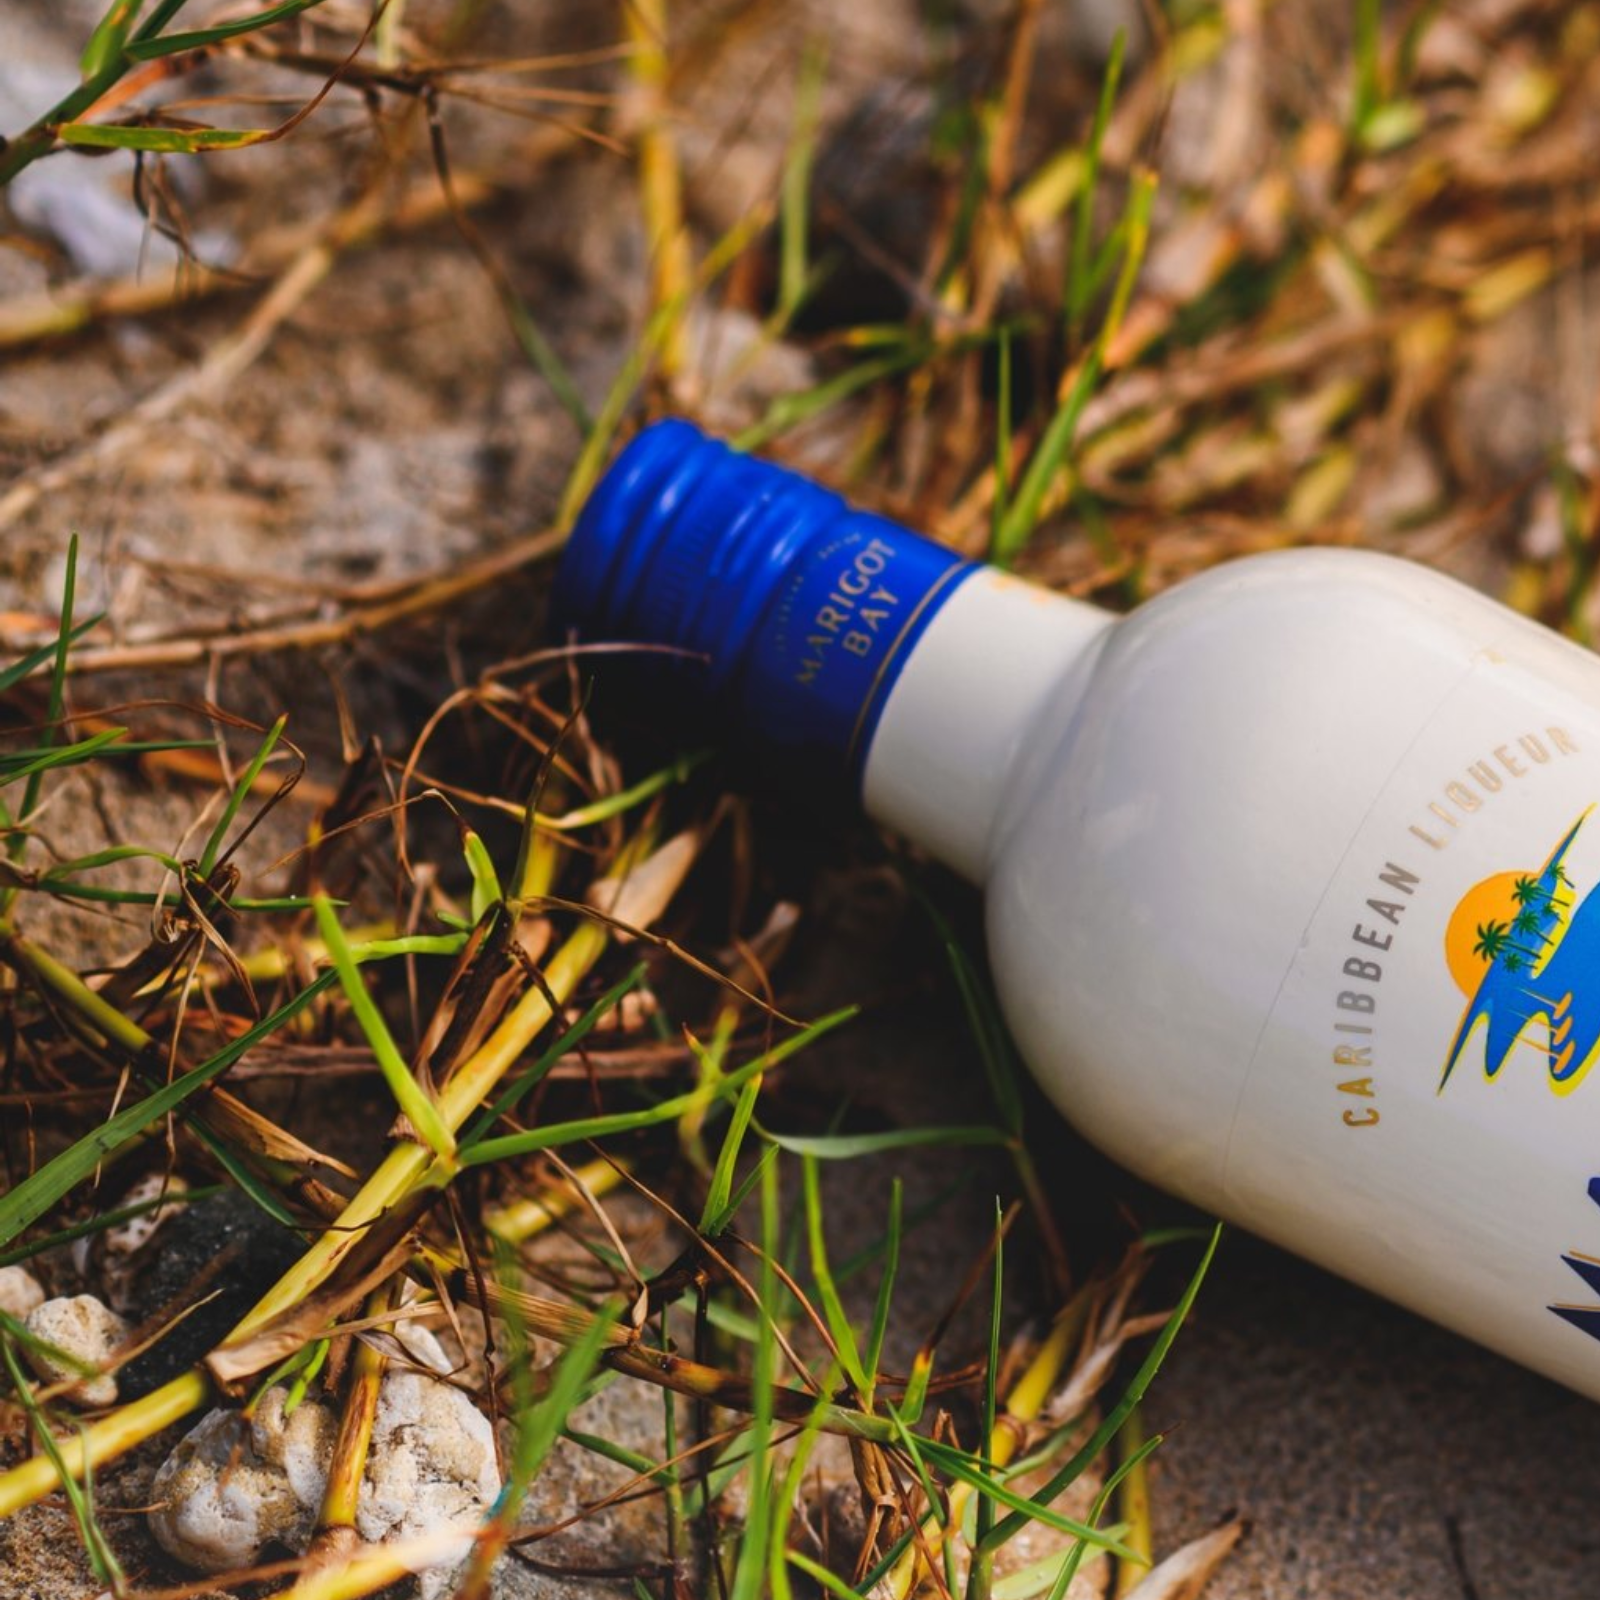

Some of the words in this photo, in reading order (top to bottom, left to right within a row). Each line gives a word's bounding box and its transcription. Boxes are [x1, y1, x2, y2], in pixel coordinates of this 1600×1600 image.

[796, 538, 896, 687] MARIGOT
[842, 585, 898, 657] BAY
[1334, 861, 1420, 1128] CARIBBEAN
[1408, 726, 1581, 849] LIQUEUR
